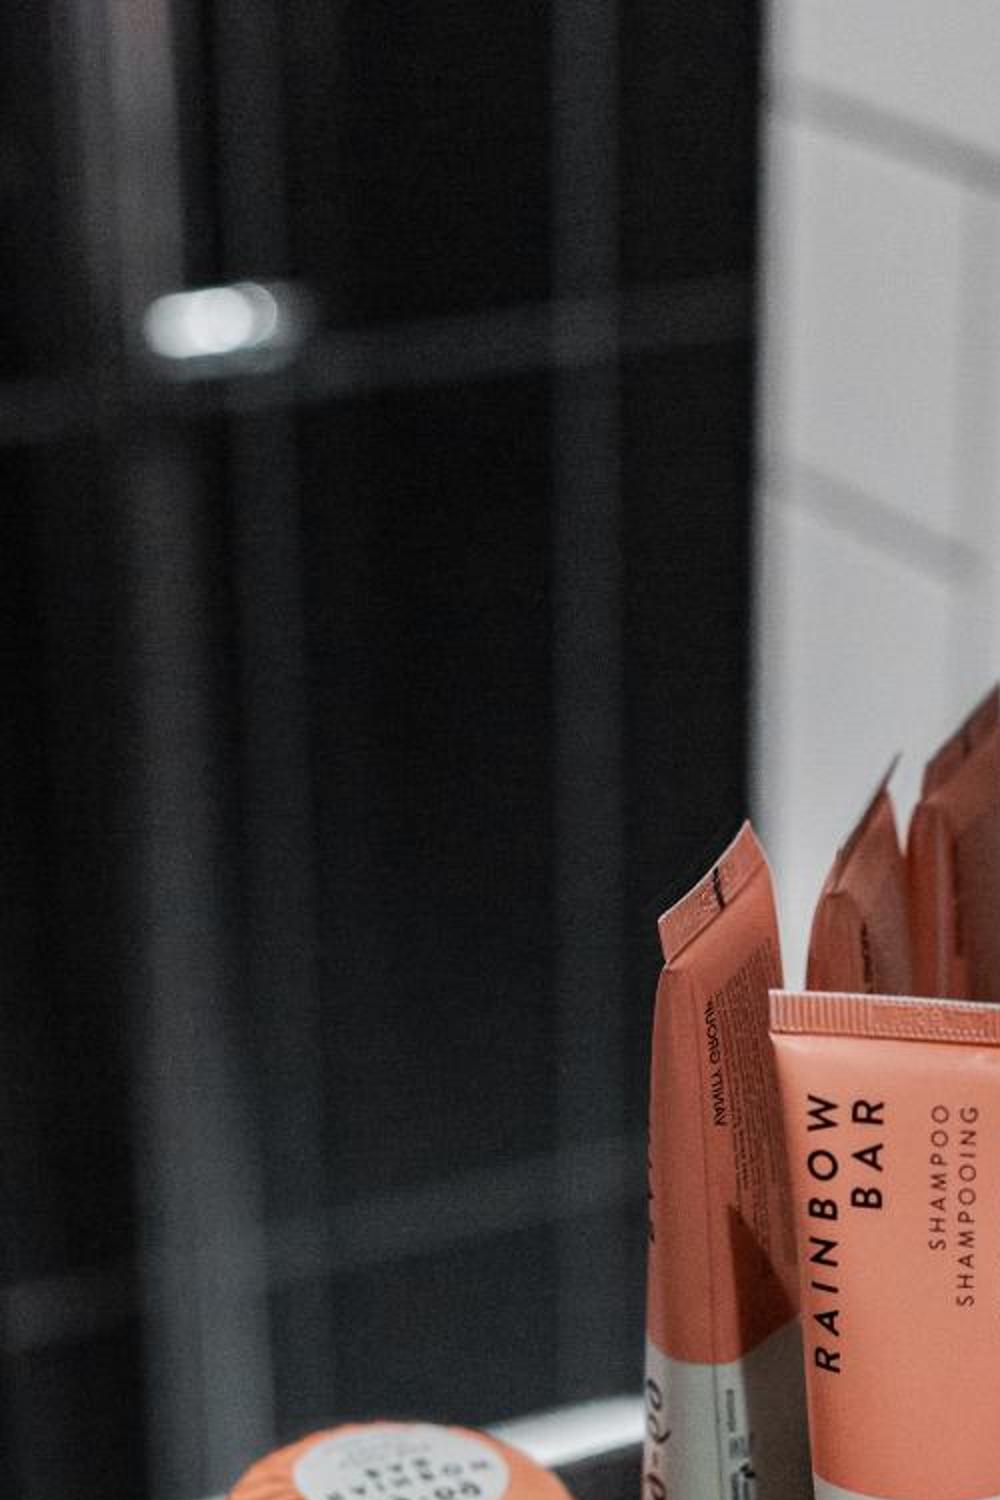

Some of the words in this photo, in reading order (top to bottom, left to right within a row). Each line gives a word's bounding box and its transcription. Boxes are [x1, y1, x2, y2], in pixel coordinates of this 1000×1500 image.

[807, 1093, 841, 1374] RAINBOW
[851, 1099, 885, 1210] BAR
[928, 1105, 950, 1251] SHAMPOO
[956, 1106, 979, 1308] SHAMPOOING
